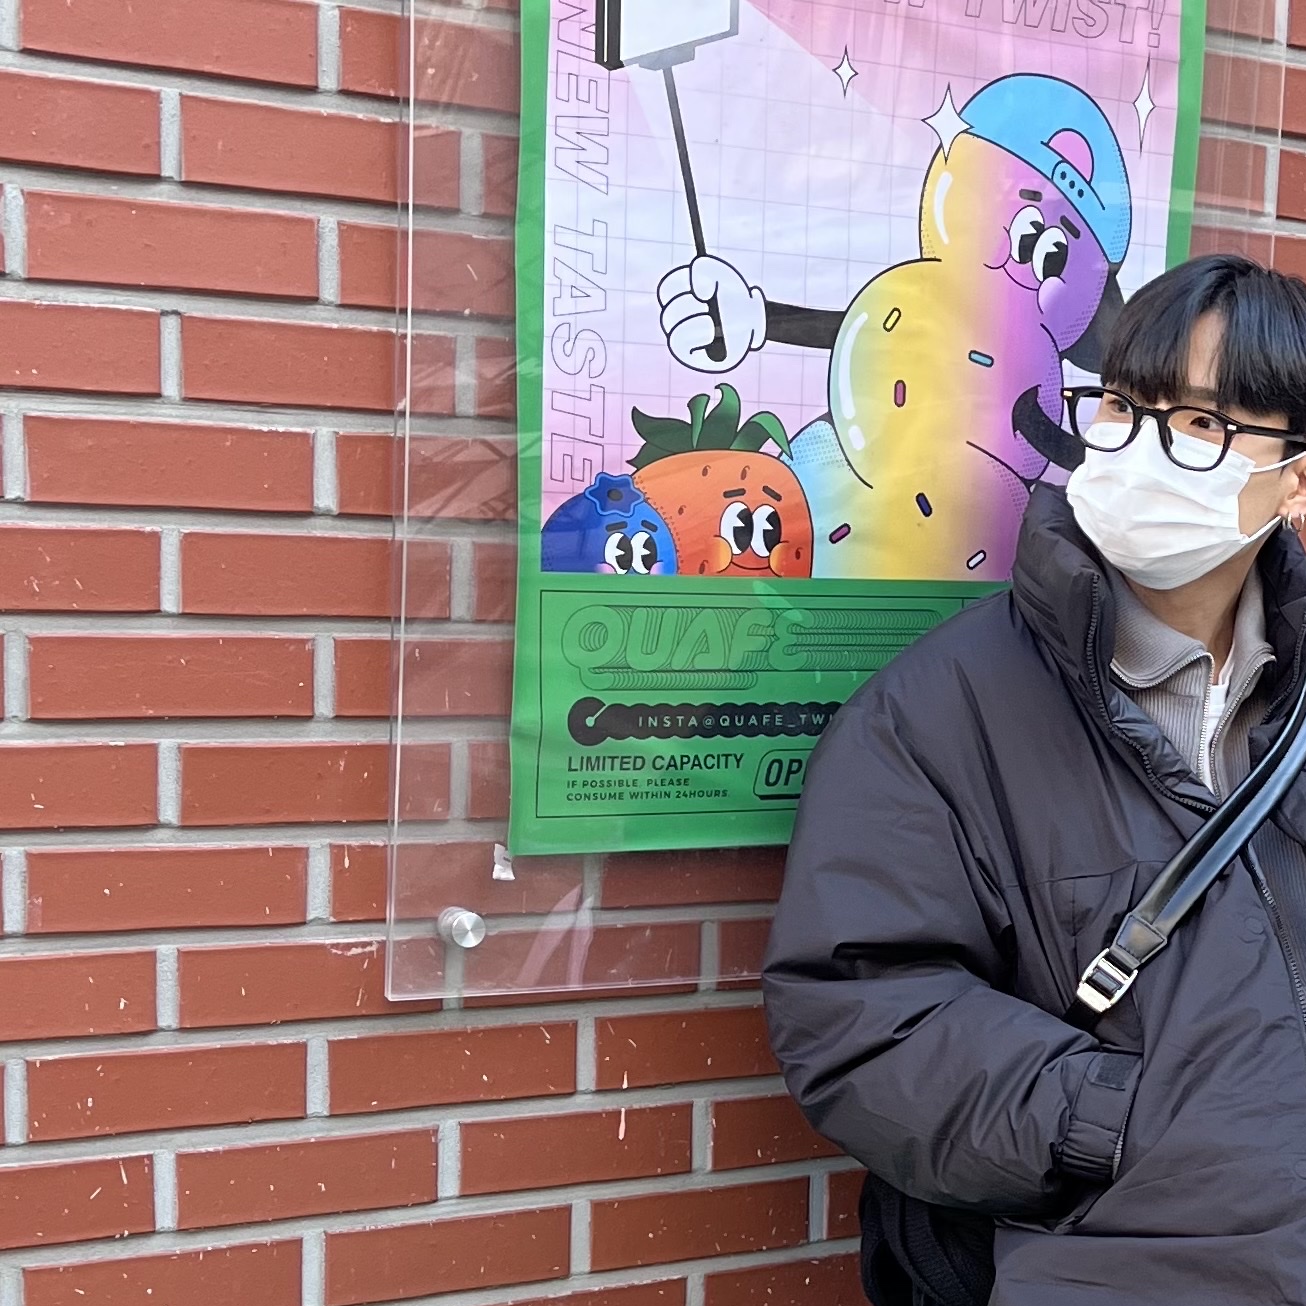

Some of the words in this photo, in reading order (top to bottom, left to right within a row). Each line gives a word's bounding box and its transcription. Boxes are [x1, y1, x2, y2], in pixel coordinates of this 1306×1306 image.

[551, 219, 607, 483] TASTE
[561, 604, 815, 691] QUAFE
[567, 755, 646, 773] LIMITED
[652, 753, 744, 771] CAPACITY
[764, 758, 807, 787] OP
[566, 780, 578, 789] IF
[646, 777, 690, 787] PLEASE
[566, 792, 625, 801] CONSUME
[629, 790, 672, 800] WITHIN
